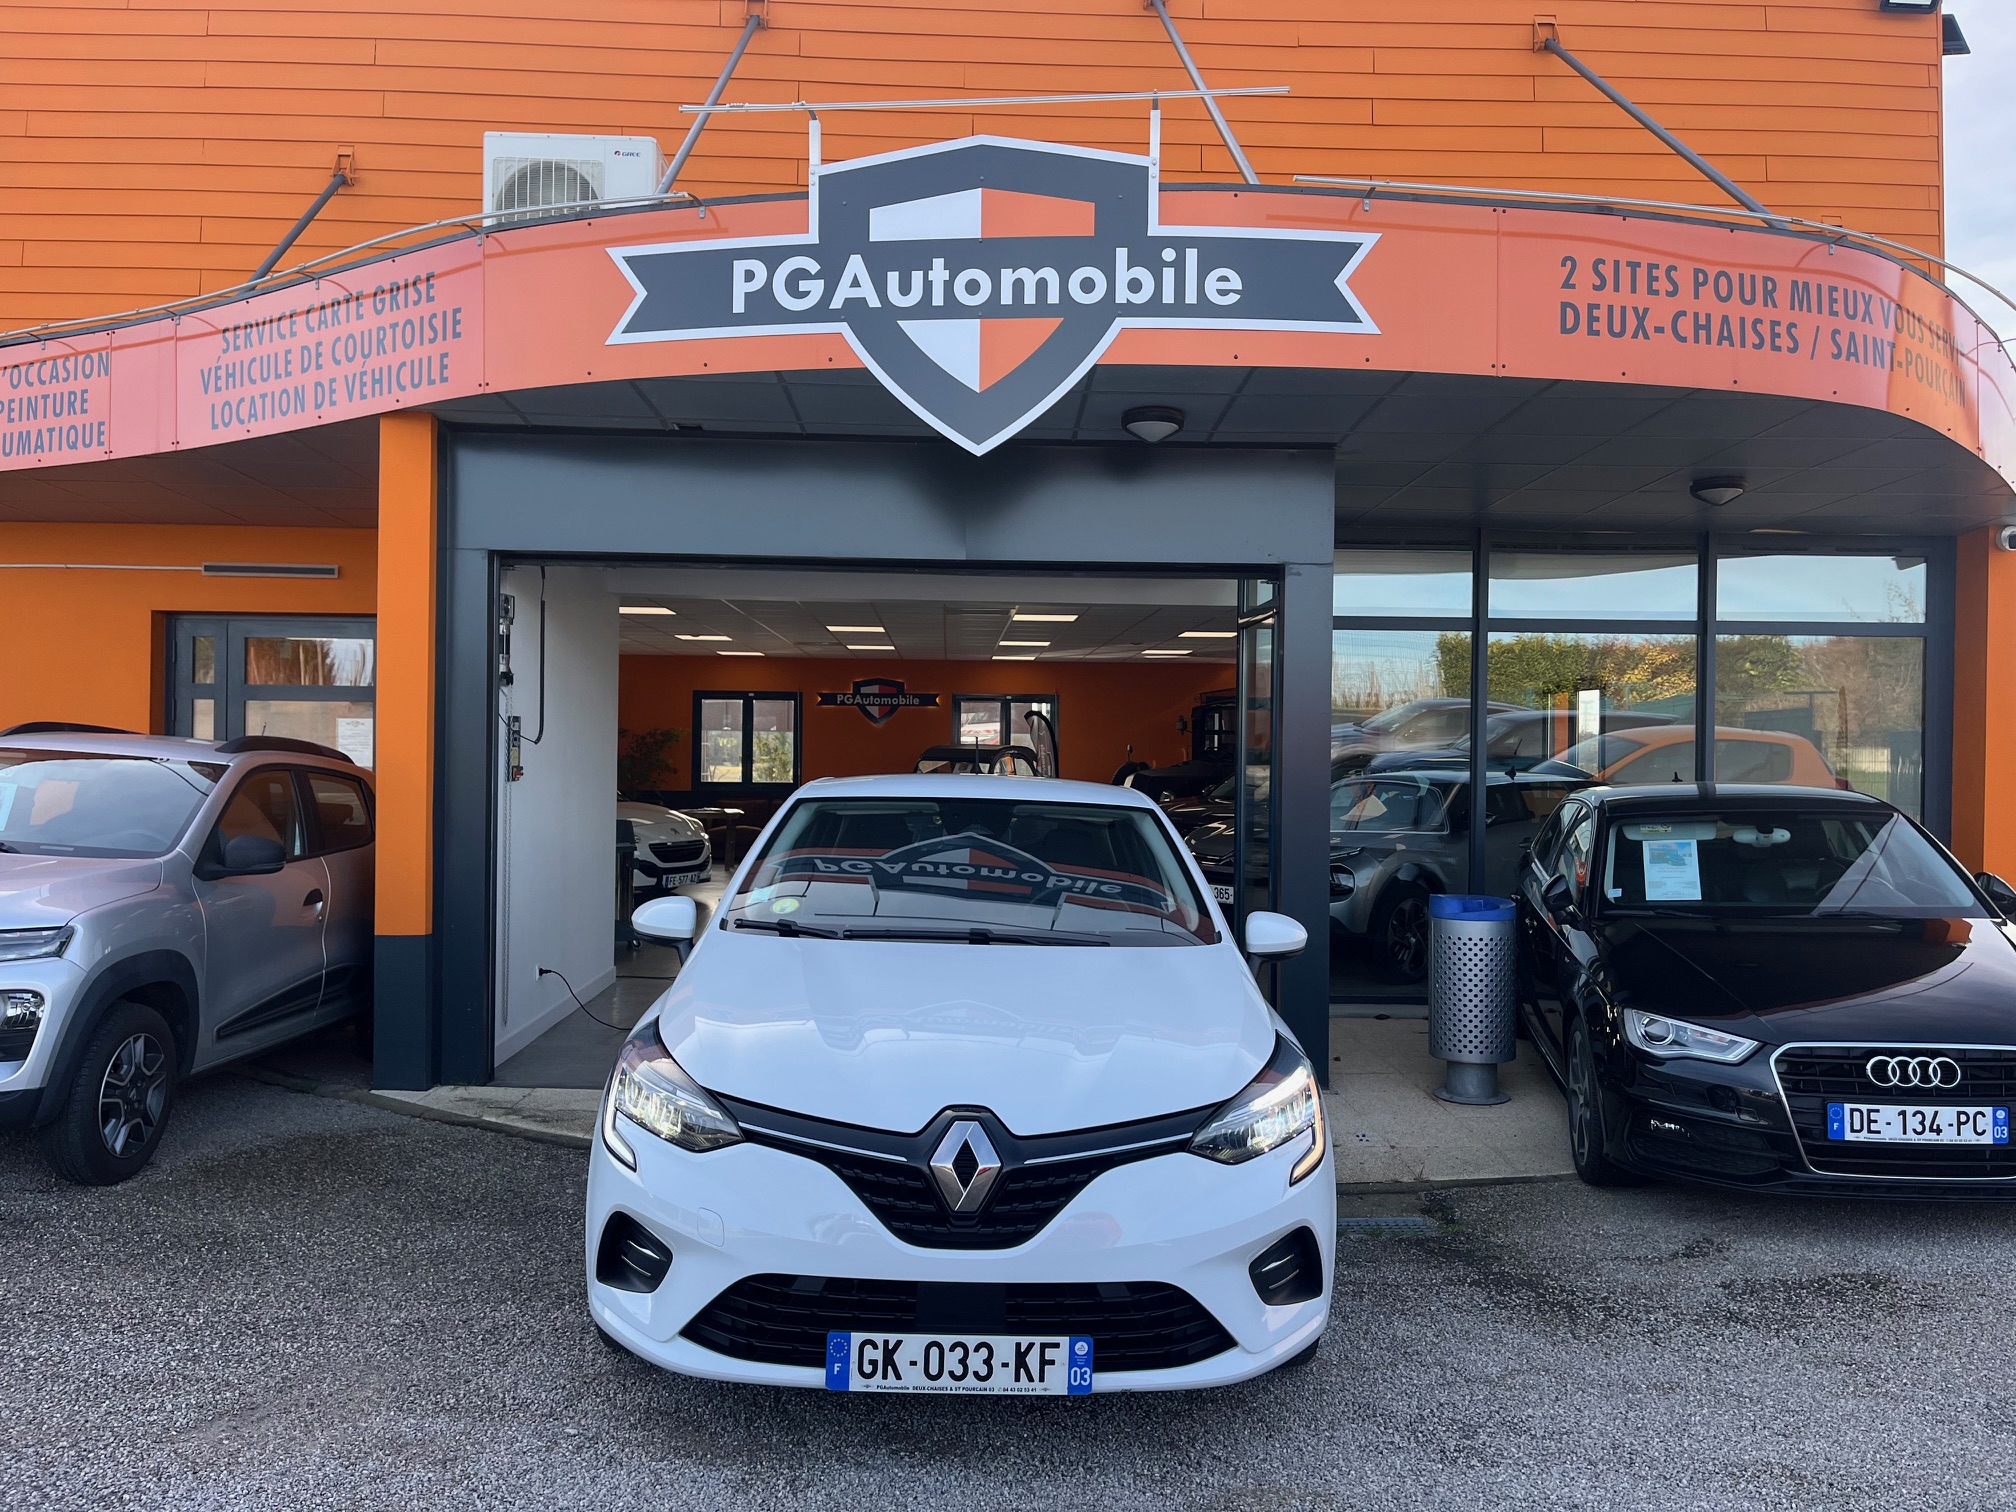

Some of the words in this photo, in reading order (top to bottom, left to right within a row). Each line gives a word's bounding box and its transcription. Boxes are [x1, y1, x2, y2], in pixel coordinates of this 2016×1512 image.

[222, 309, 298, 354] SERVICE
[305, 290, 364, 332] CARTE
[373, 271, 436, 316] GRISE
[732, 247, 1243, 314] PGAutomobile
[1560, 255, 1578, 290] 2
[1592, 257, 1680, 298] SITES
[1693, 267, 1778, 309] POUR
[1789, 279, 1874, 325] MIEUX
[1879, 297, 1925, 344] VOUS
[200, 348, 292, 395] VÉHICULE
[300, 341, 323, 375] DE
[331, 307, 462, 366] COURTOISIE
[1560, 301, 1800, 354] DEUX-CHAISES
[1830, 327, 1966, 410] SAINT-POURÇAIN
[211, 384, 305, 430] LOCATION
[314, 377, 337, 410] DE
[344, 352, 449, 403] VÉHICULE
[2, 421, 105, 458] UMATIQUE
[836, 693, 920, 705] PGAutomobile
[1833, 1122, 1839, 1131] F
[1849, 1107, 1987, 1137] DE-134-PC
[1994, 1126, 2008, 1138] 03
[833, 1363, 841, 1375] F
[857, 1338, 1061, 1383] GK-033-KF
[1070, 1366, 1091, 1386] 03
